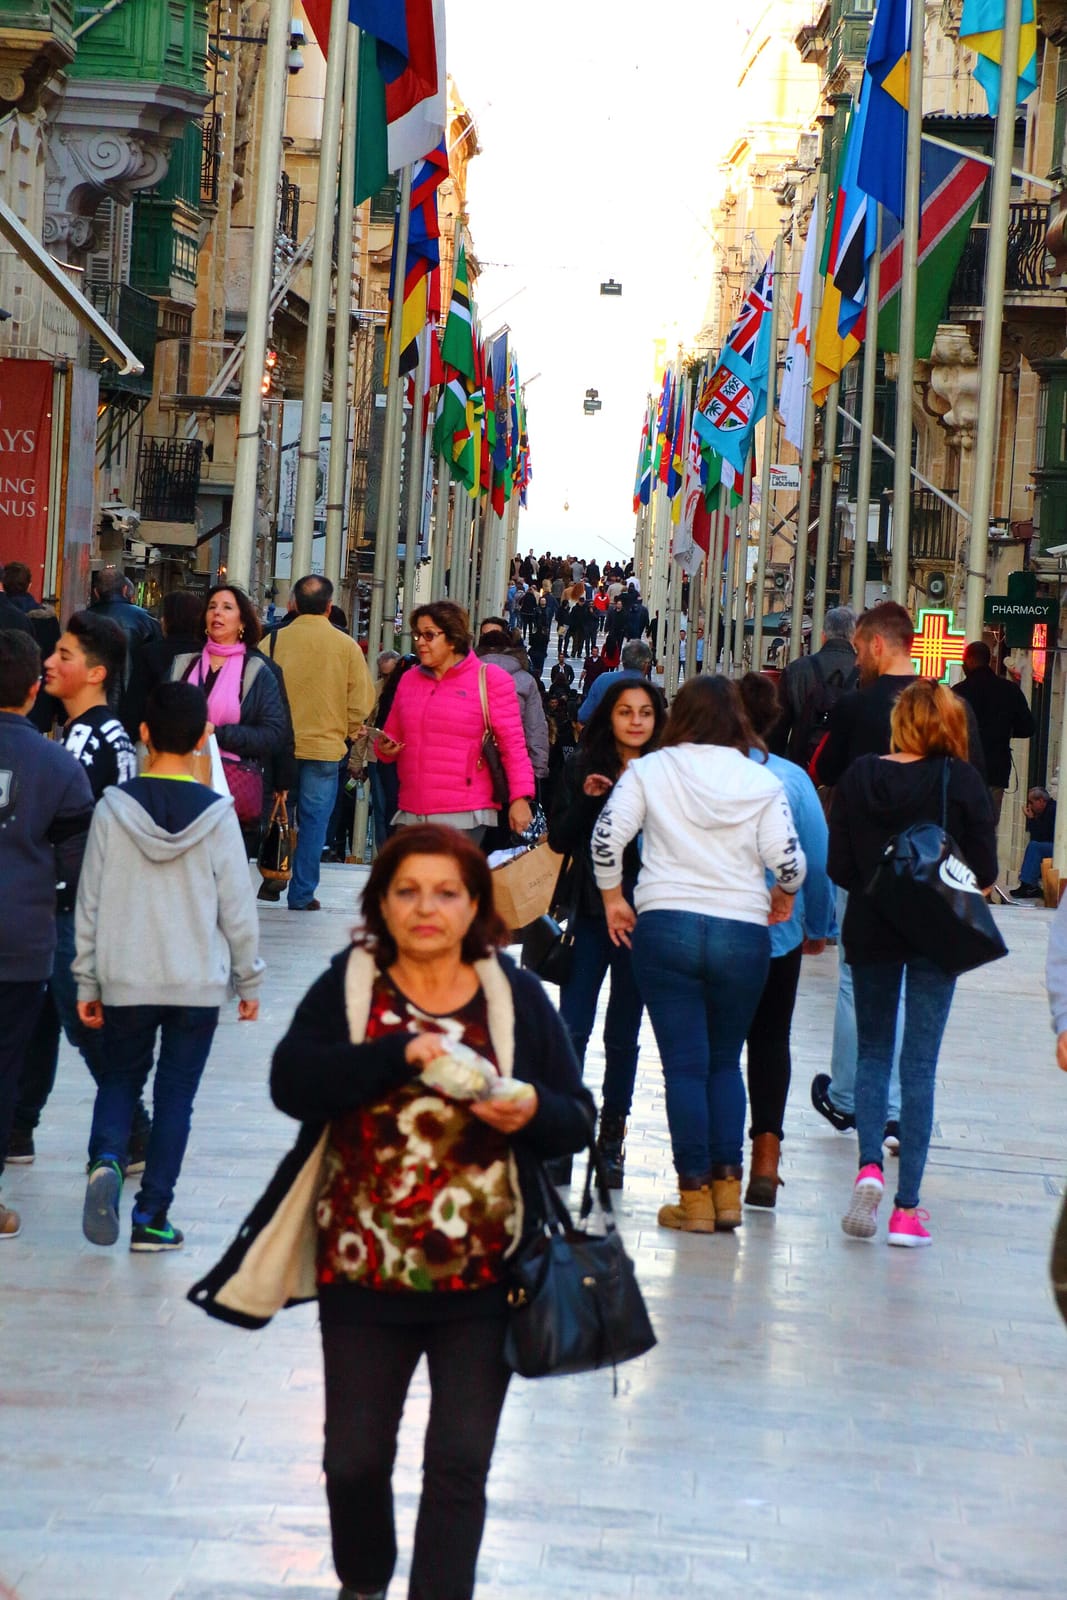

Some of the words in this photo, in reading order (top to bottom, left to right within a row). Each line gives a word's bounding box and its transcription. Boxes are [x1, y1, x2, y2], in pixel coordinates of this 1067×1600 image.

[0, 429, 35, 453] YS
[772, 480, 799, 488] Laburista
[992, 605, 1049, 615] PHARMACY
[593, 826, 616, 867] LOVE
[946, 853, 978, 887] NIKE
